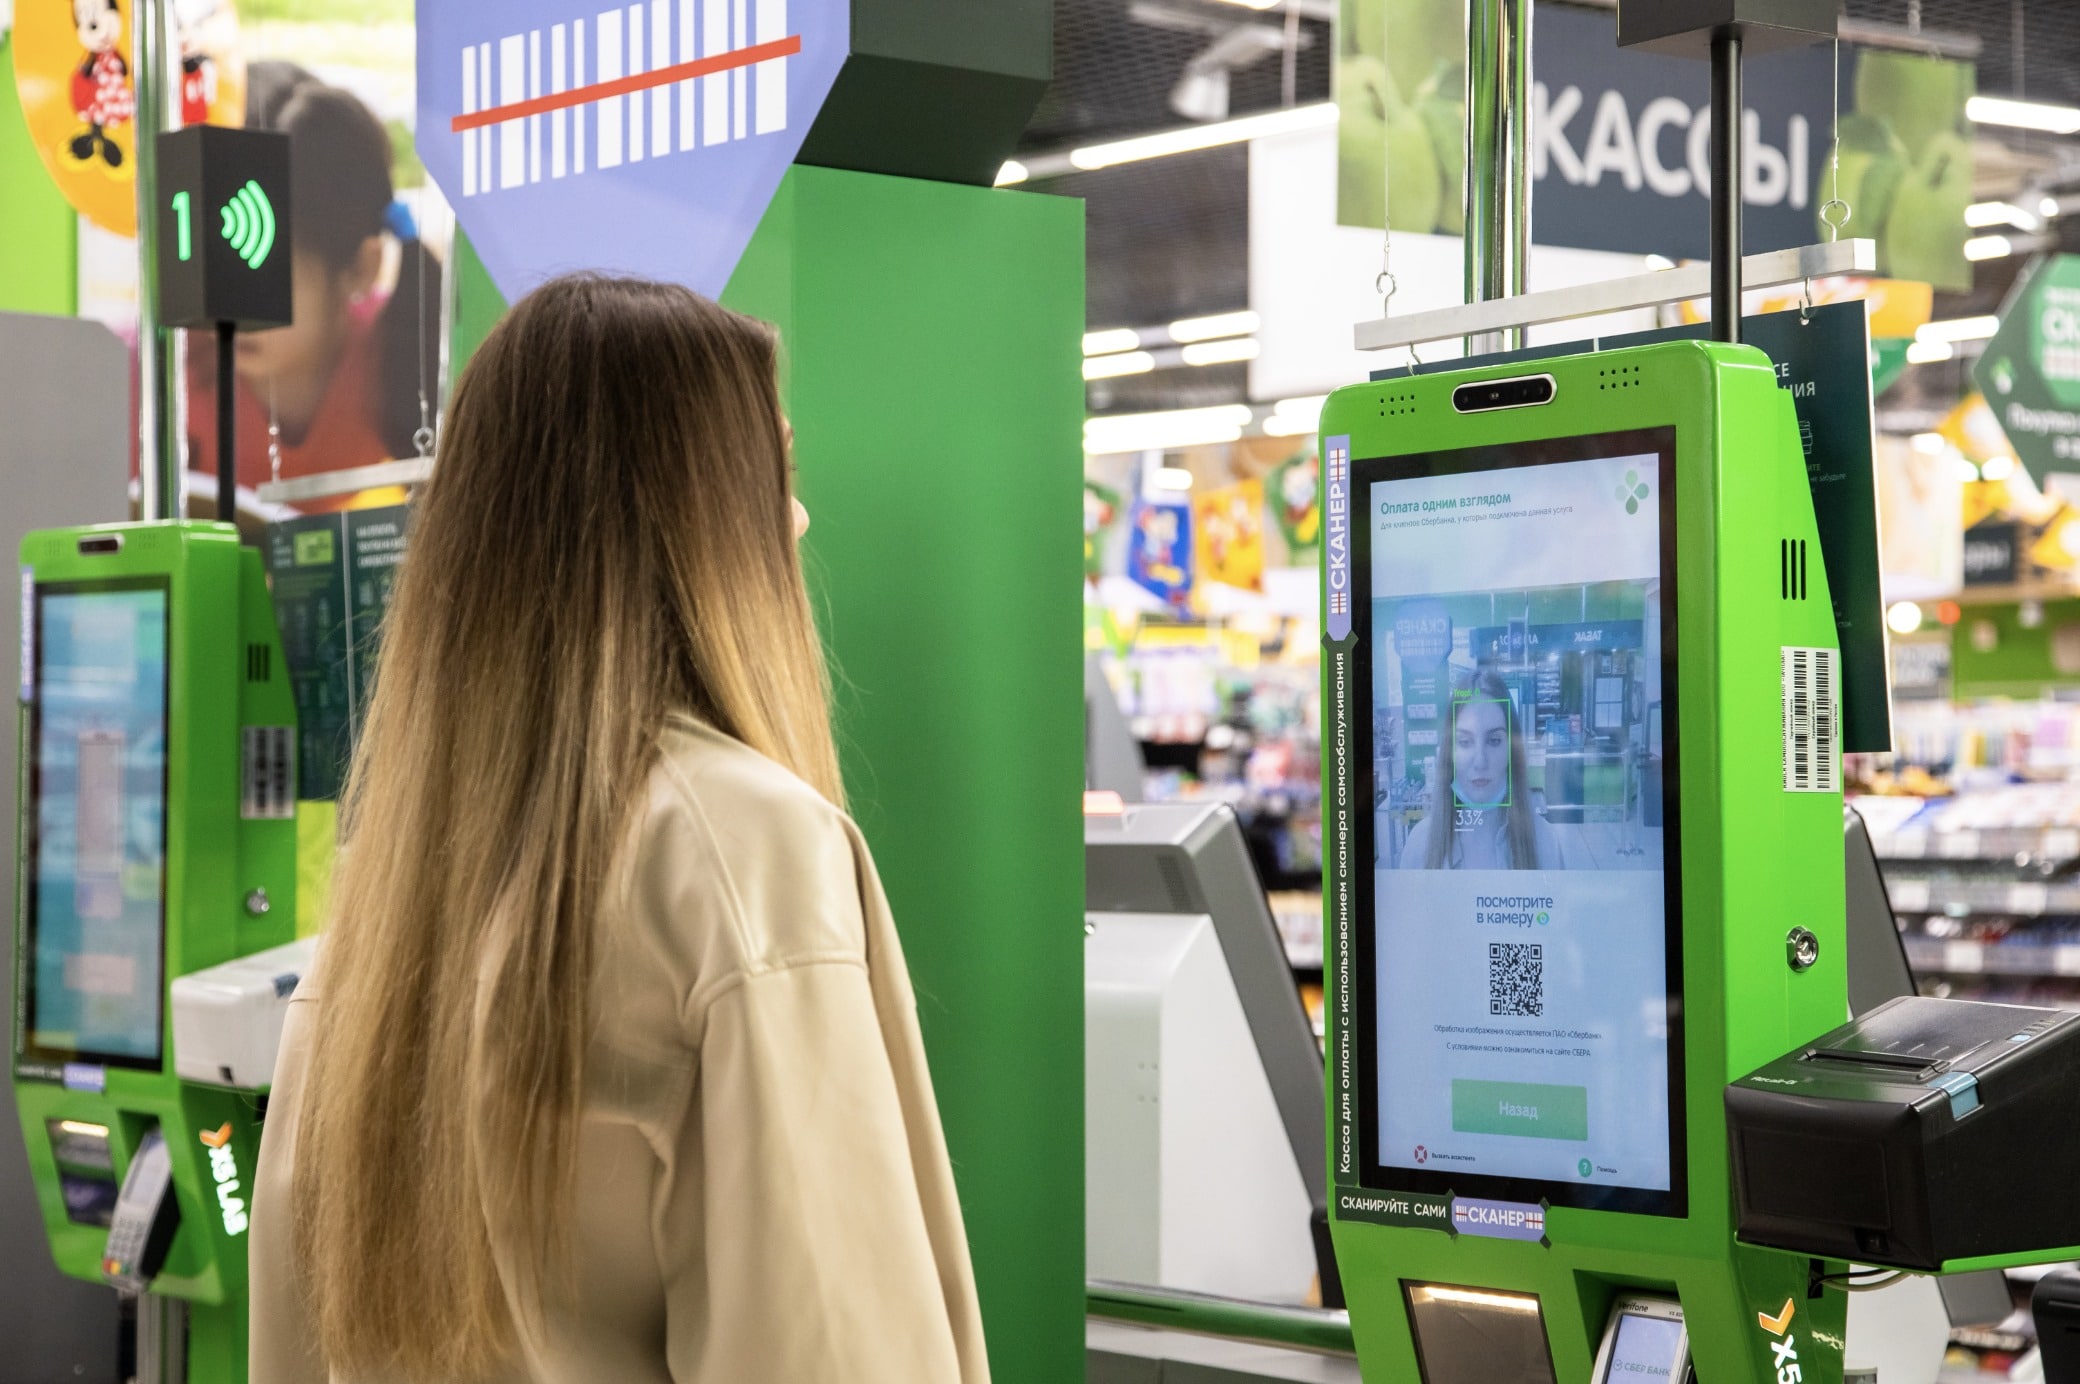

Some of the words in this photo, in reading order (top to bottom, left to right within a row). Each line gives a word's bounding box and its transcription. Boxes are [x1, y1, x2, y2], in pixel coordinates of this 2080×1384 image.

[1532, 82, 1809, 210] КАССЫ
[172, 191, 191, 261] 1
[1381, 502, 1420, 515] Оплата
[1422, 499, 1457, 512] одним
[1460, 494, 1511, 507] взглядом
[1330, 485, 1346, 589] СКАНЕР
[1335, 653, 1347, 806] самообслуживания
[1455, 809, 1484, 826] 33%
[1338, 811, 1349, 878] сканера
[1476, 896, 1554, 912] посмотрите
[1476, 912, 1484, 924] в
[1487, 912, 1534, 928] камеру
[1340, 882, 1349, 1013] использованием
[1342, 1016, 1349, 1026] с
[1434, 1024, 1465, 1034] Обработка
[1465, 1026, 1504, 1036] изображения
[1552, 1029, 1567, 1038] ПАО
[1342, 1030, 1350, 1089] оплаты
[1545, 1048, 1554, 1056] на
[1554, 1048, 1571, 1057] сайте
[1342, 1093, 1352, 1122] для
[1499, 1099, 1539, 1121] Назад
[1341, 1125, 1350, 1173] Касса
[216, 1178, 249, 1236] LAB
[1341, 1196, 1409, 1215] СКАНИРУЙТЕ
[1413, 1203, 1447, 1218] САМИ
[1468, 1206, 1526, 1227] СКАНЕР
[1624, 1362, 1645, 1373] СБЕР
[1647, 1365, 1671, 1377] БАНК
[1770, 1334, 1803, 1384] X5
